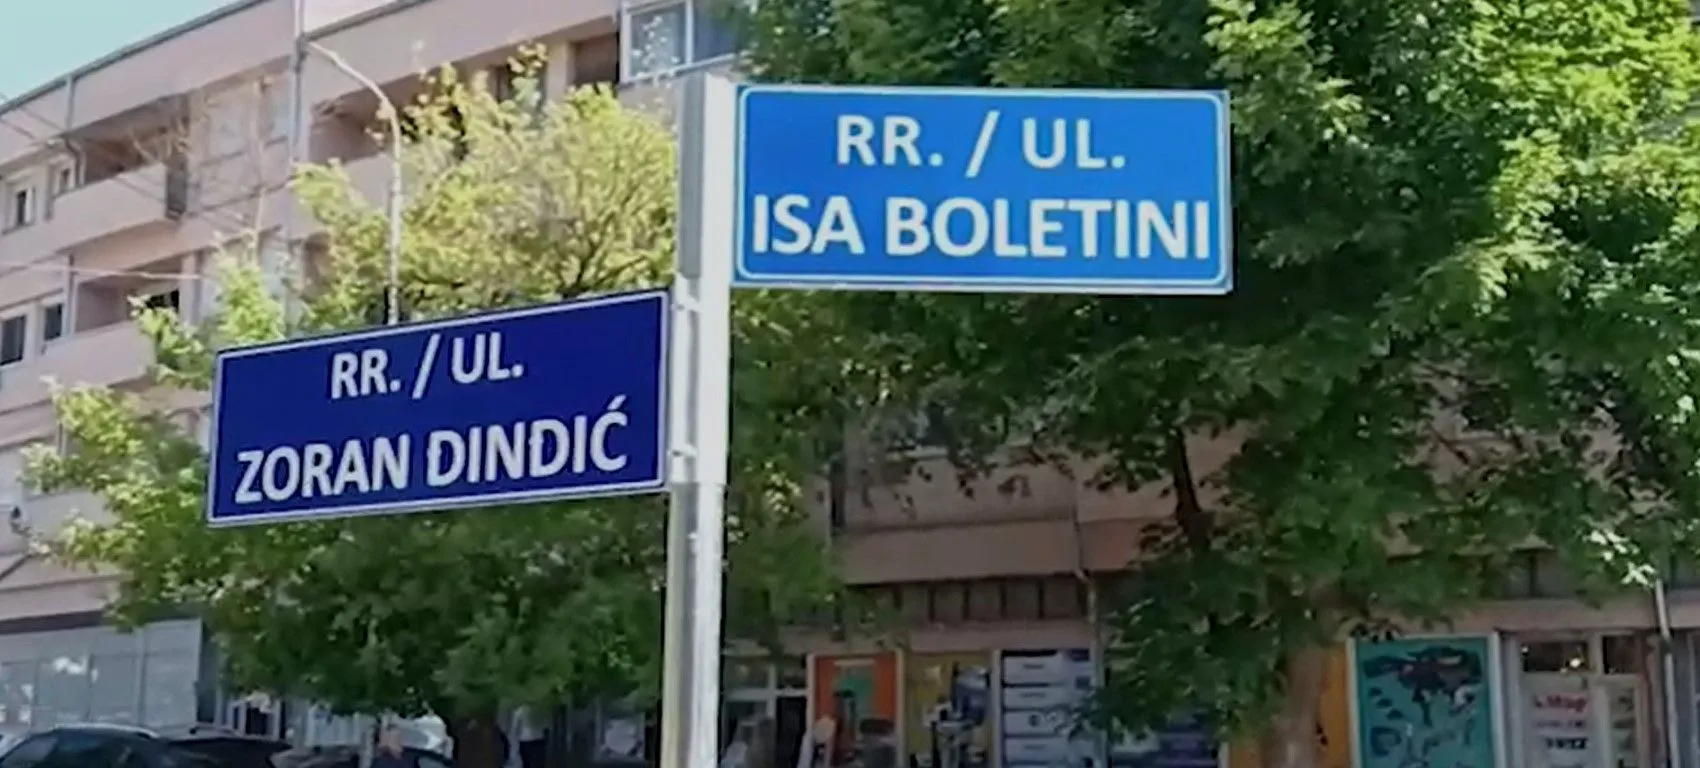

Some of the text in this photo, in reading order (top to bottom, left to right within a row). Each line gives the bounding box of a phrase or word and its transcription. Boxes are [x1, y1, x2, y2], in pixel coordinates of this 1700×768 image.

[837, 111, 1126, 177] RR. / UL.
[752, 195, 1210, 259] ISA BOLETINI
[330, 332, 524, 400] RR. / UL.
[235, 395, 628, 504] ZORAN ĐINĐIĆ
